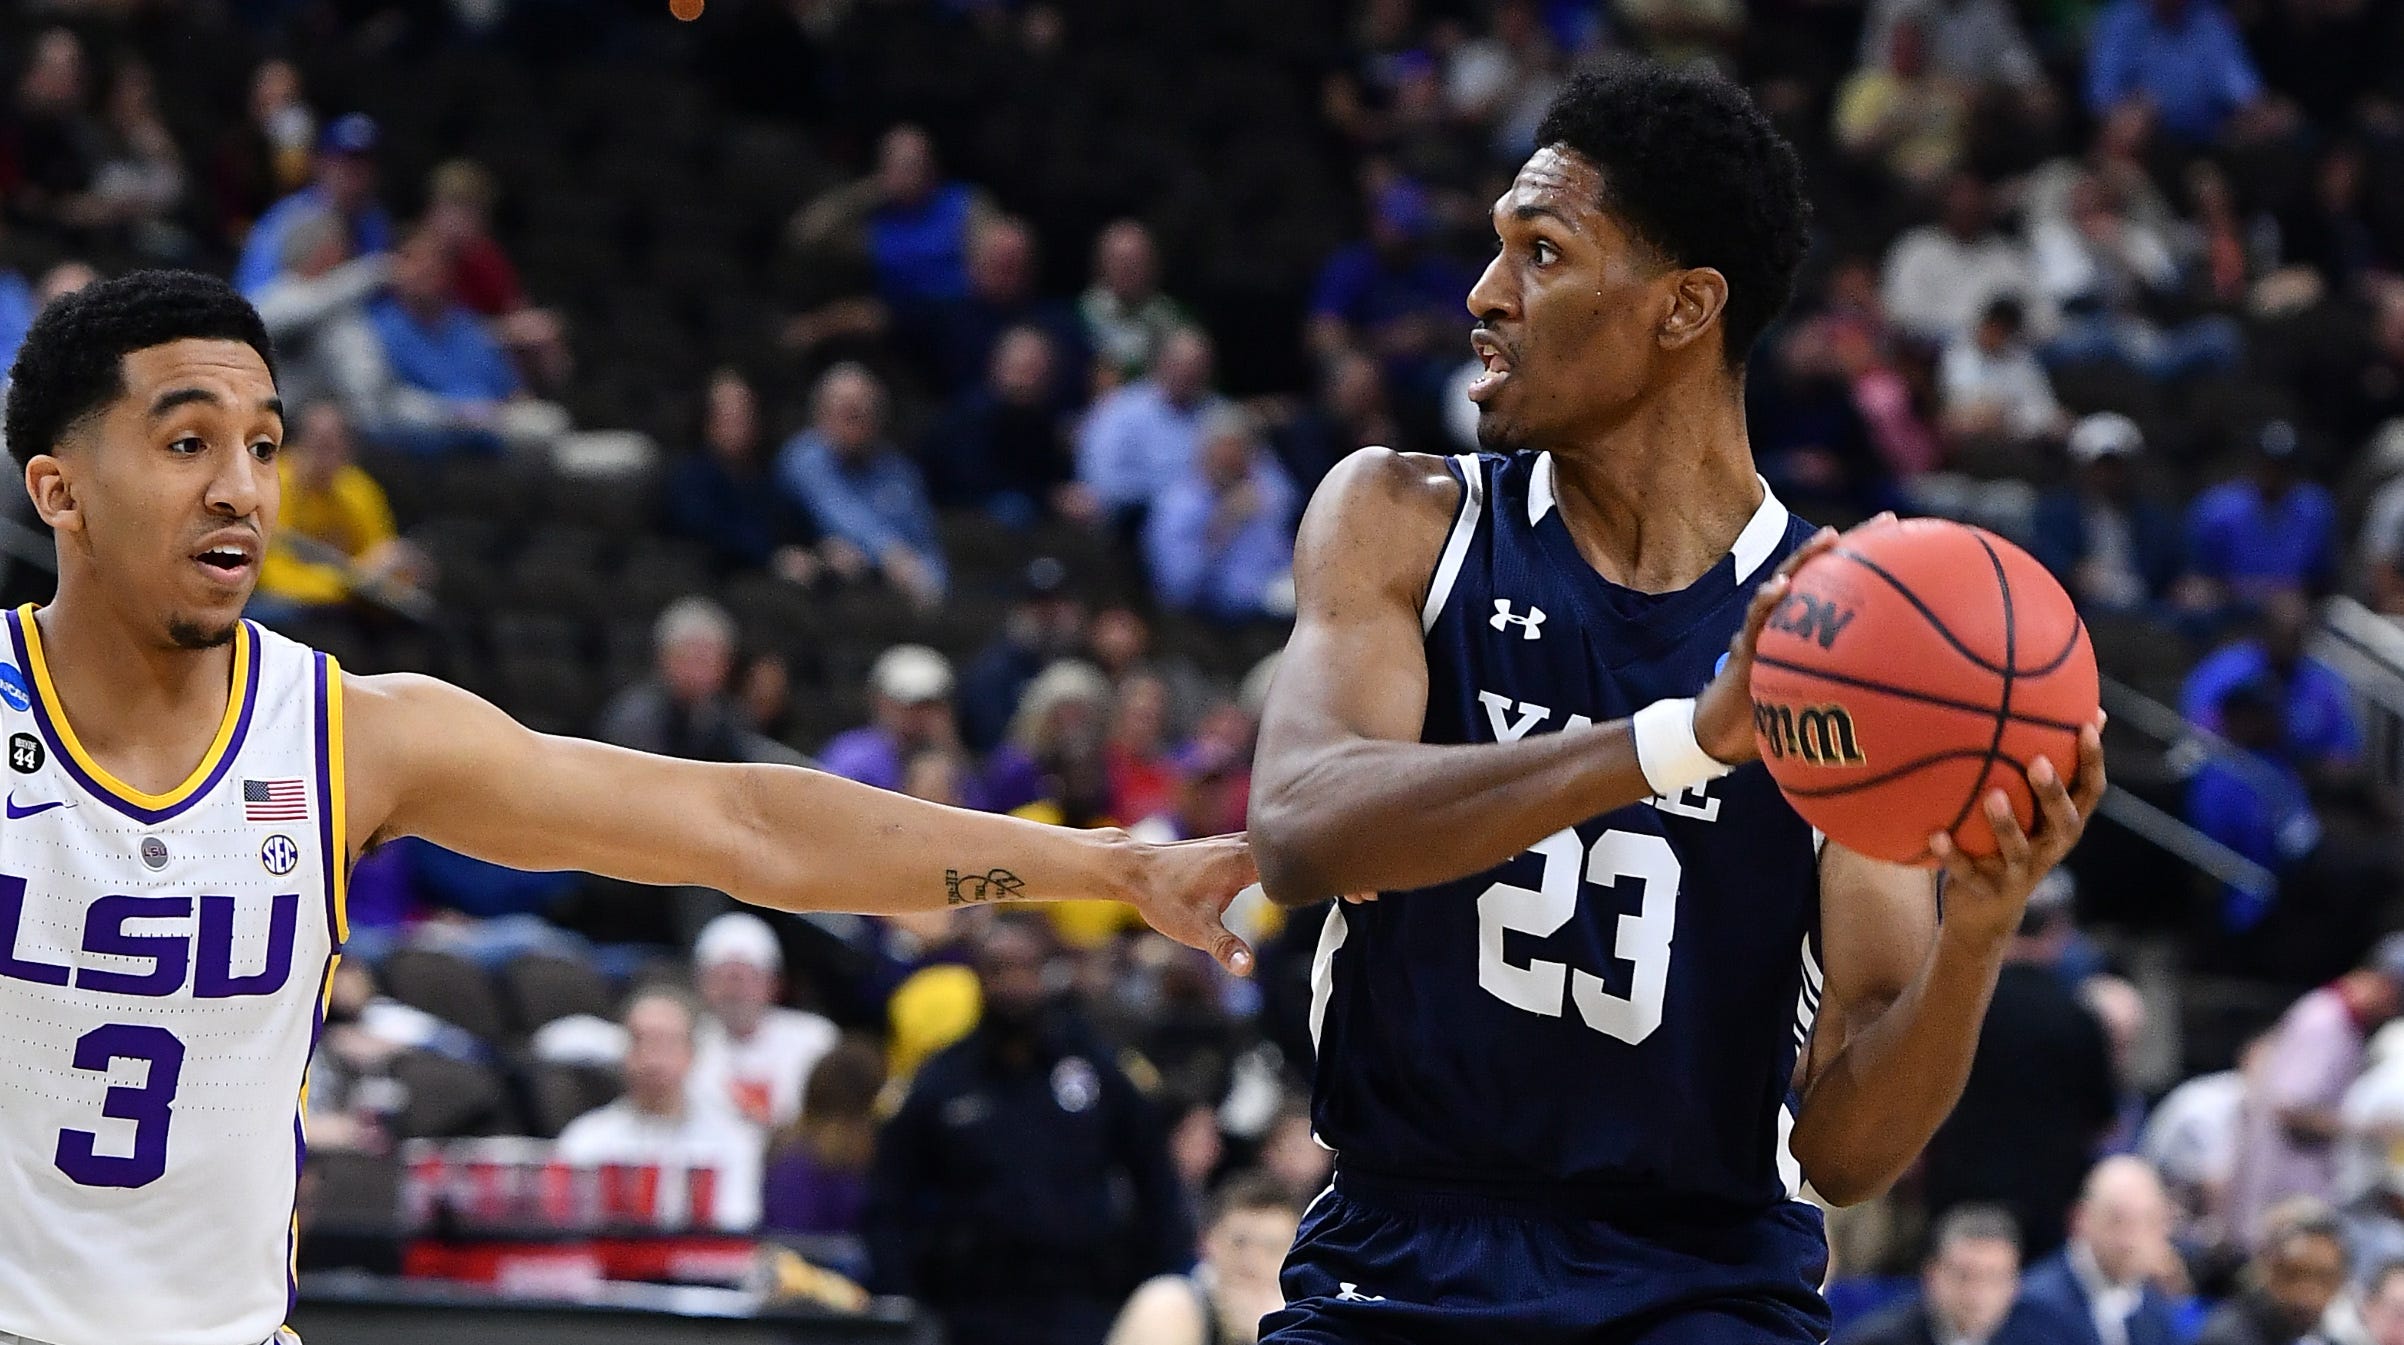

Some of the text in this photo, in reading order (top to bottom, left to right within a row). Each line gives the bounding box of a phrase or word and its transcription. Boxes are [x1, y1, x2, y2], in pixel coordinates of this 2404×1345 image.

[13, 747, 36, 769] 44
[1478, 689, 1721, 823] YE
[143, 846, 168, 858] LSU
[262, 836, 298, 873] SEC
[0, 873, 300, 998] LSU
[1477, 826, 1682, 1046] 23
[54, 1023, 186, 1189] 3
